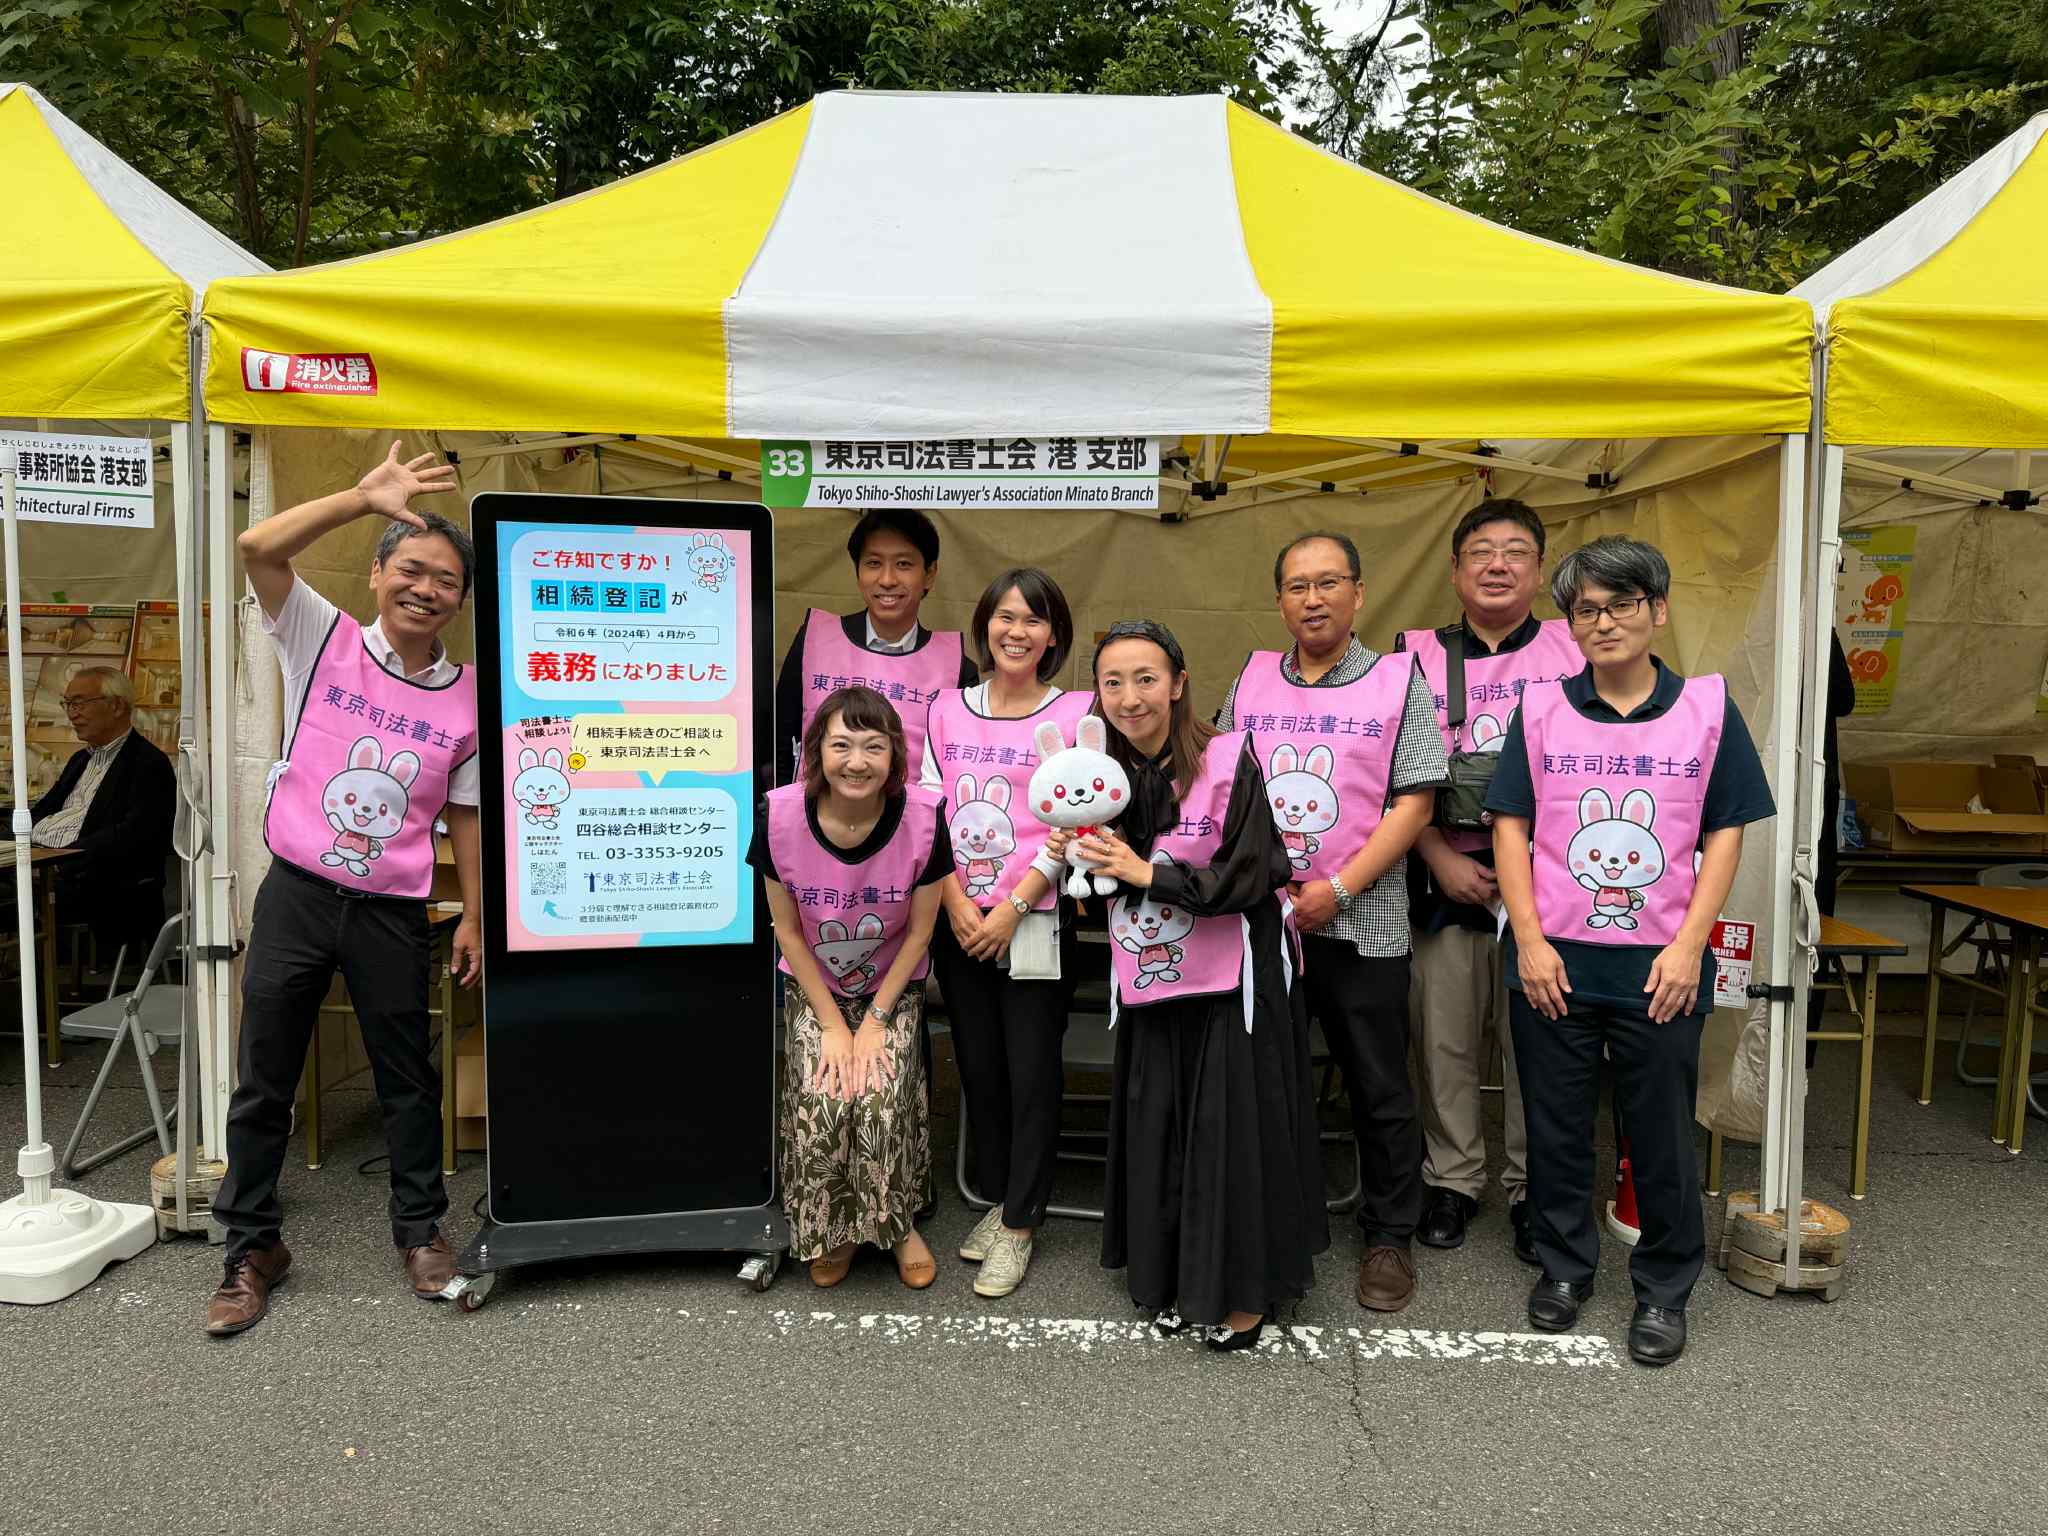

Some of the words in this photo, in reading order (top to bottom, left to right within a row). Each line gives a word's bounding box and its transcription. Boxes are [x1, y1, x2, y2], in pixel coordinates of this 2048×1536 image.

[293, 358, 370, 383] 消火器
[291, 380, 311, 389] Fire
[313, 382, 372, 392] extinguisher
[768, 449, 806, 477] 33
[825, 438, 1037, 471] 東京司法書士会
[15, 450, 96, 484] 事務所協会
[100, 456, 148, 488] 港支部
[818, 485, 852, 504] Tokyo
[855, 485, 934, 502] Shiho-Shoshi
[937, 485, 991, 505] Lawyer's
[992, 486, 1063, 502] Association
[1065, 486, 1108, 502] Minato
[1111, 486, 1154, 502] Branch
[94, 502, 136, 519] Firms
[527, 650, 728, 683] 義務になりました
[586, 726, 724, 740] 相続手続きのご相談は
[1241, 713, 1384, 739] 東京司法書士会
[600, 746, 712, 759] 東京司法書士会へ
[577, 807, 647, 817] 東京司法書士会
[576, 822, 727, 837] 四谷総合相談センター
[576, 851, 600, 860] TEL.
[606, 846, 724, 860] 03-3353-9205
[601, 869, 713, 886] 東京司法書士会
